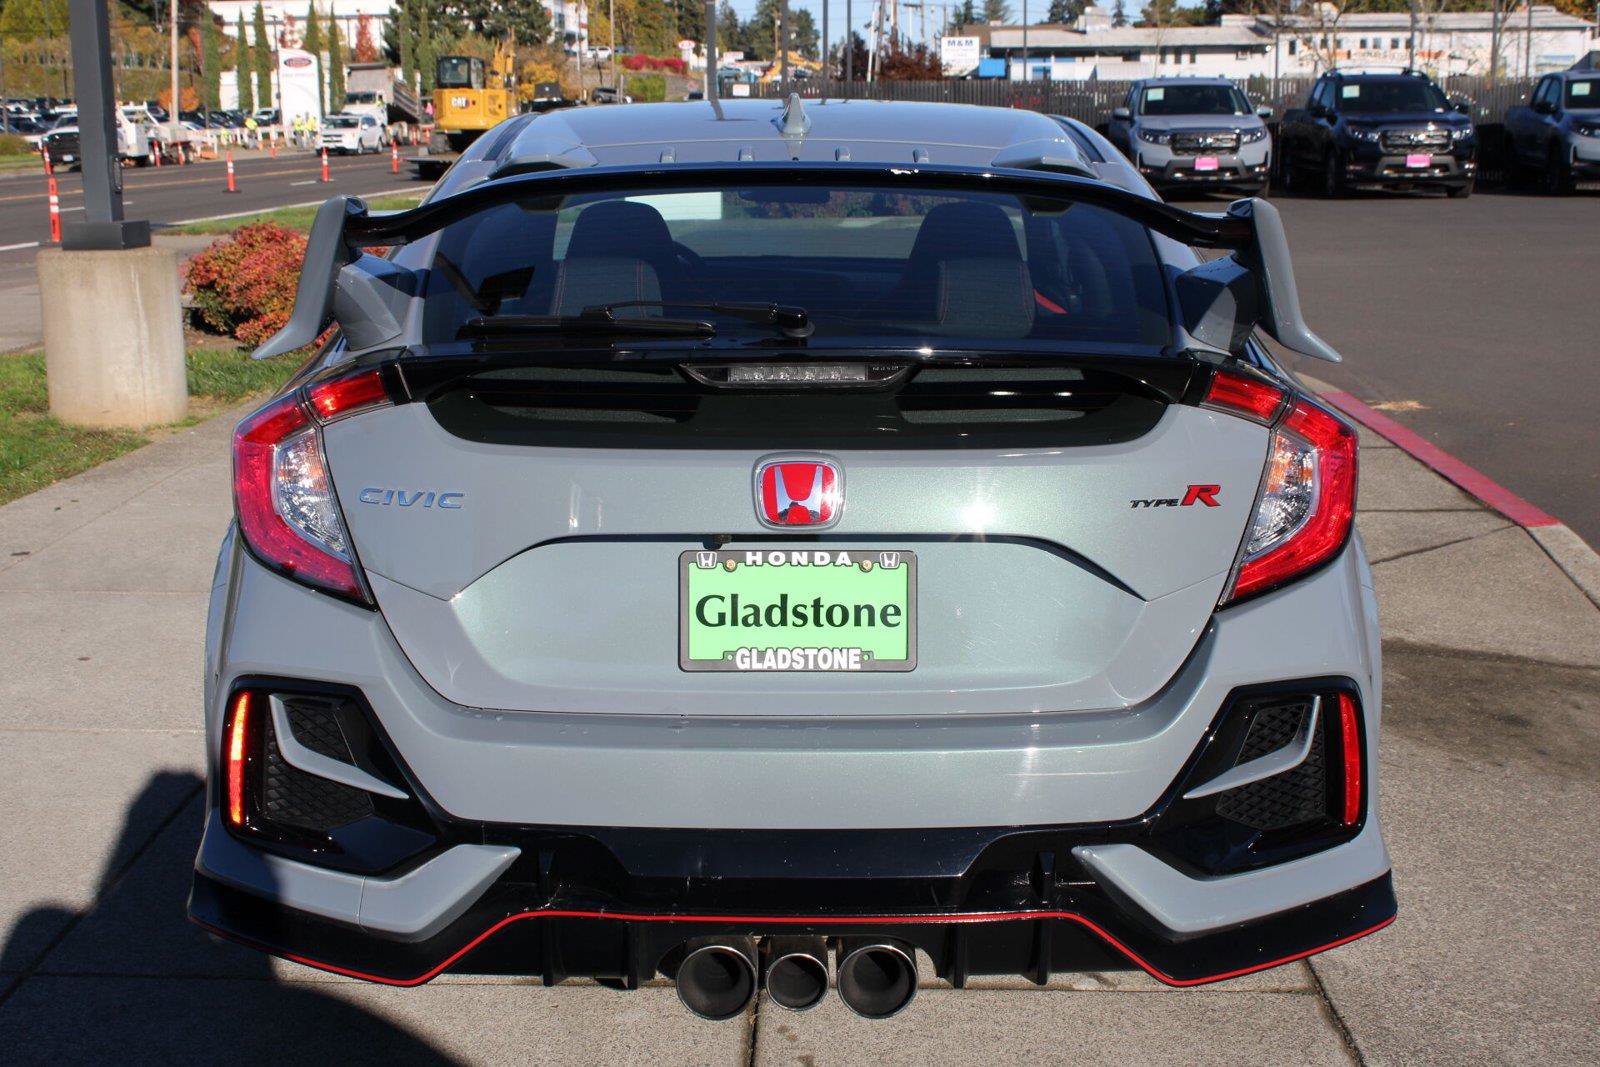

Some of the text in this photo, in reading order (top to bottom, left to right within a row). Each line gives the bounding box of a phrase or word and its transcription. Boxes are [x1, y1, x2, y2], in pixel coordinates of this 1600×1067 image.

[360, 487, 464, 509] CIVIC
[1130, 484, 1221, 509] TYPE R
[745, 551, 853, 566] HONDA
[695, 593, 902, 627] Gladstone
[735, 647, 861, 670] GLADSTONE
